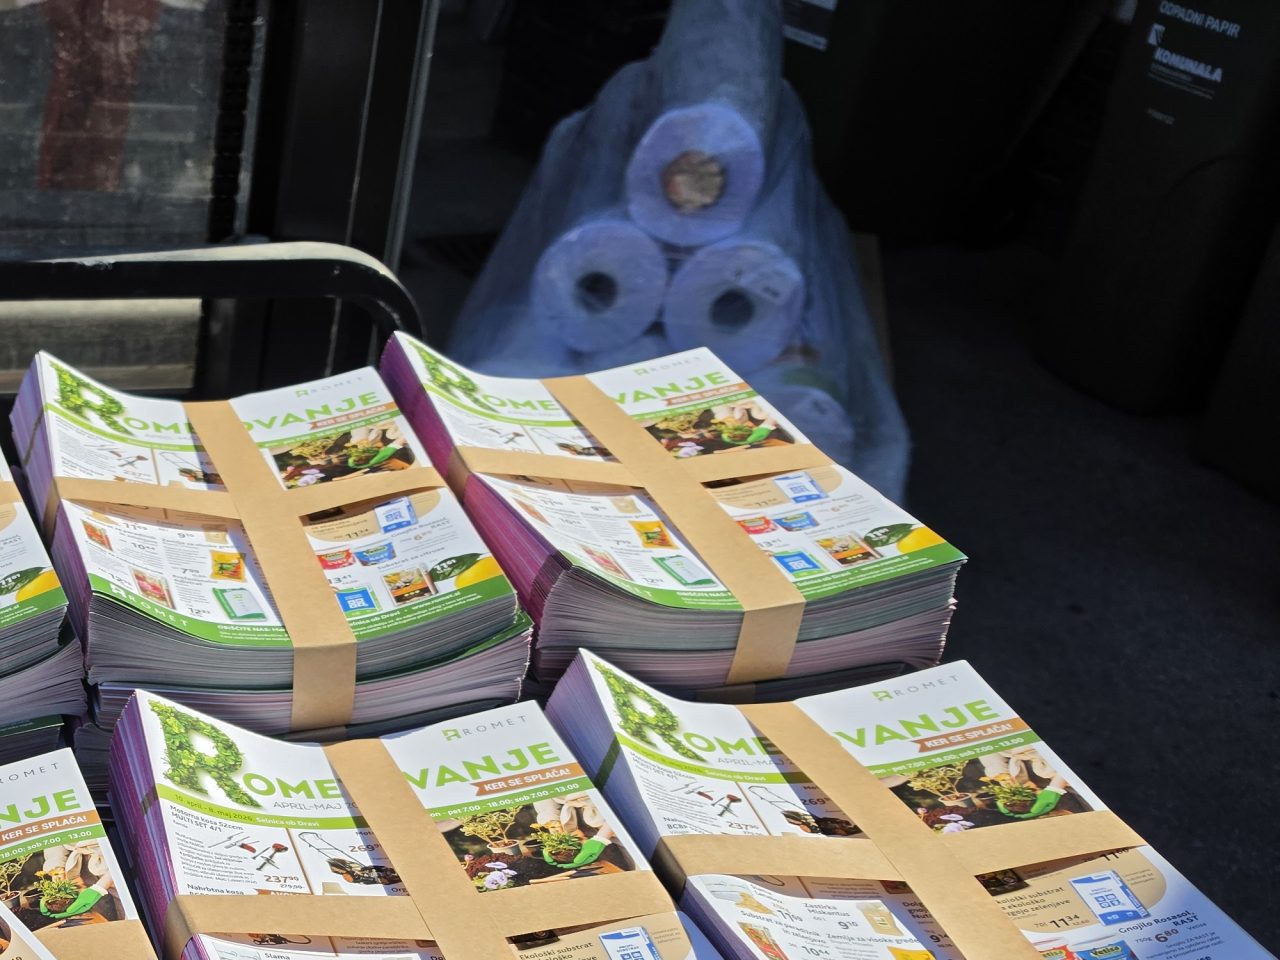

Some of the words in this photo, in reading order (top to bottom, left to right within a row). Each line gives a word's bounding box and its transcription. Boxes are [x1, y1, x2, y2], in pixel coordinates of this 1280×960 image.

[1205, 15, 1241, 39] PAPIR
[894, 675, 959, 696] ROMET
[463, 715, 527, 736] ROMET
[924, 737, 945, 749] KER
[966, 723, 1013, 740] SPLAČA!
[484, 780, 507, 792] KER
[509, 776, 522, 787] SE
[524, 768, 571, 783] SPLAČA!
[1, 830, 24, 842] KER
[25, 827, 39, 837] SE
[41, 815, 87, 832] SPLAČA!
[69, 830, 92, 842] 13.00
[1172, 915, 1200, 928] RAST
